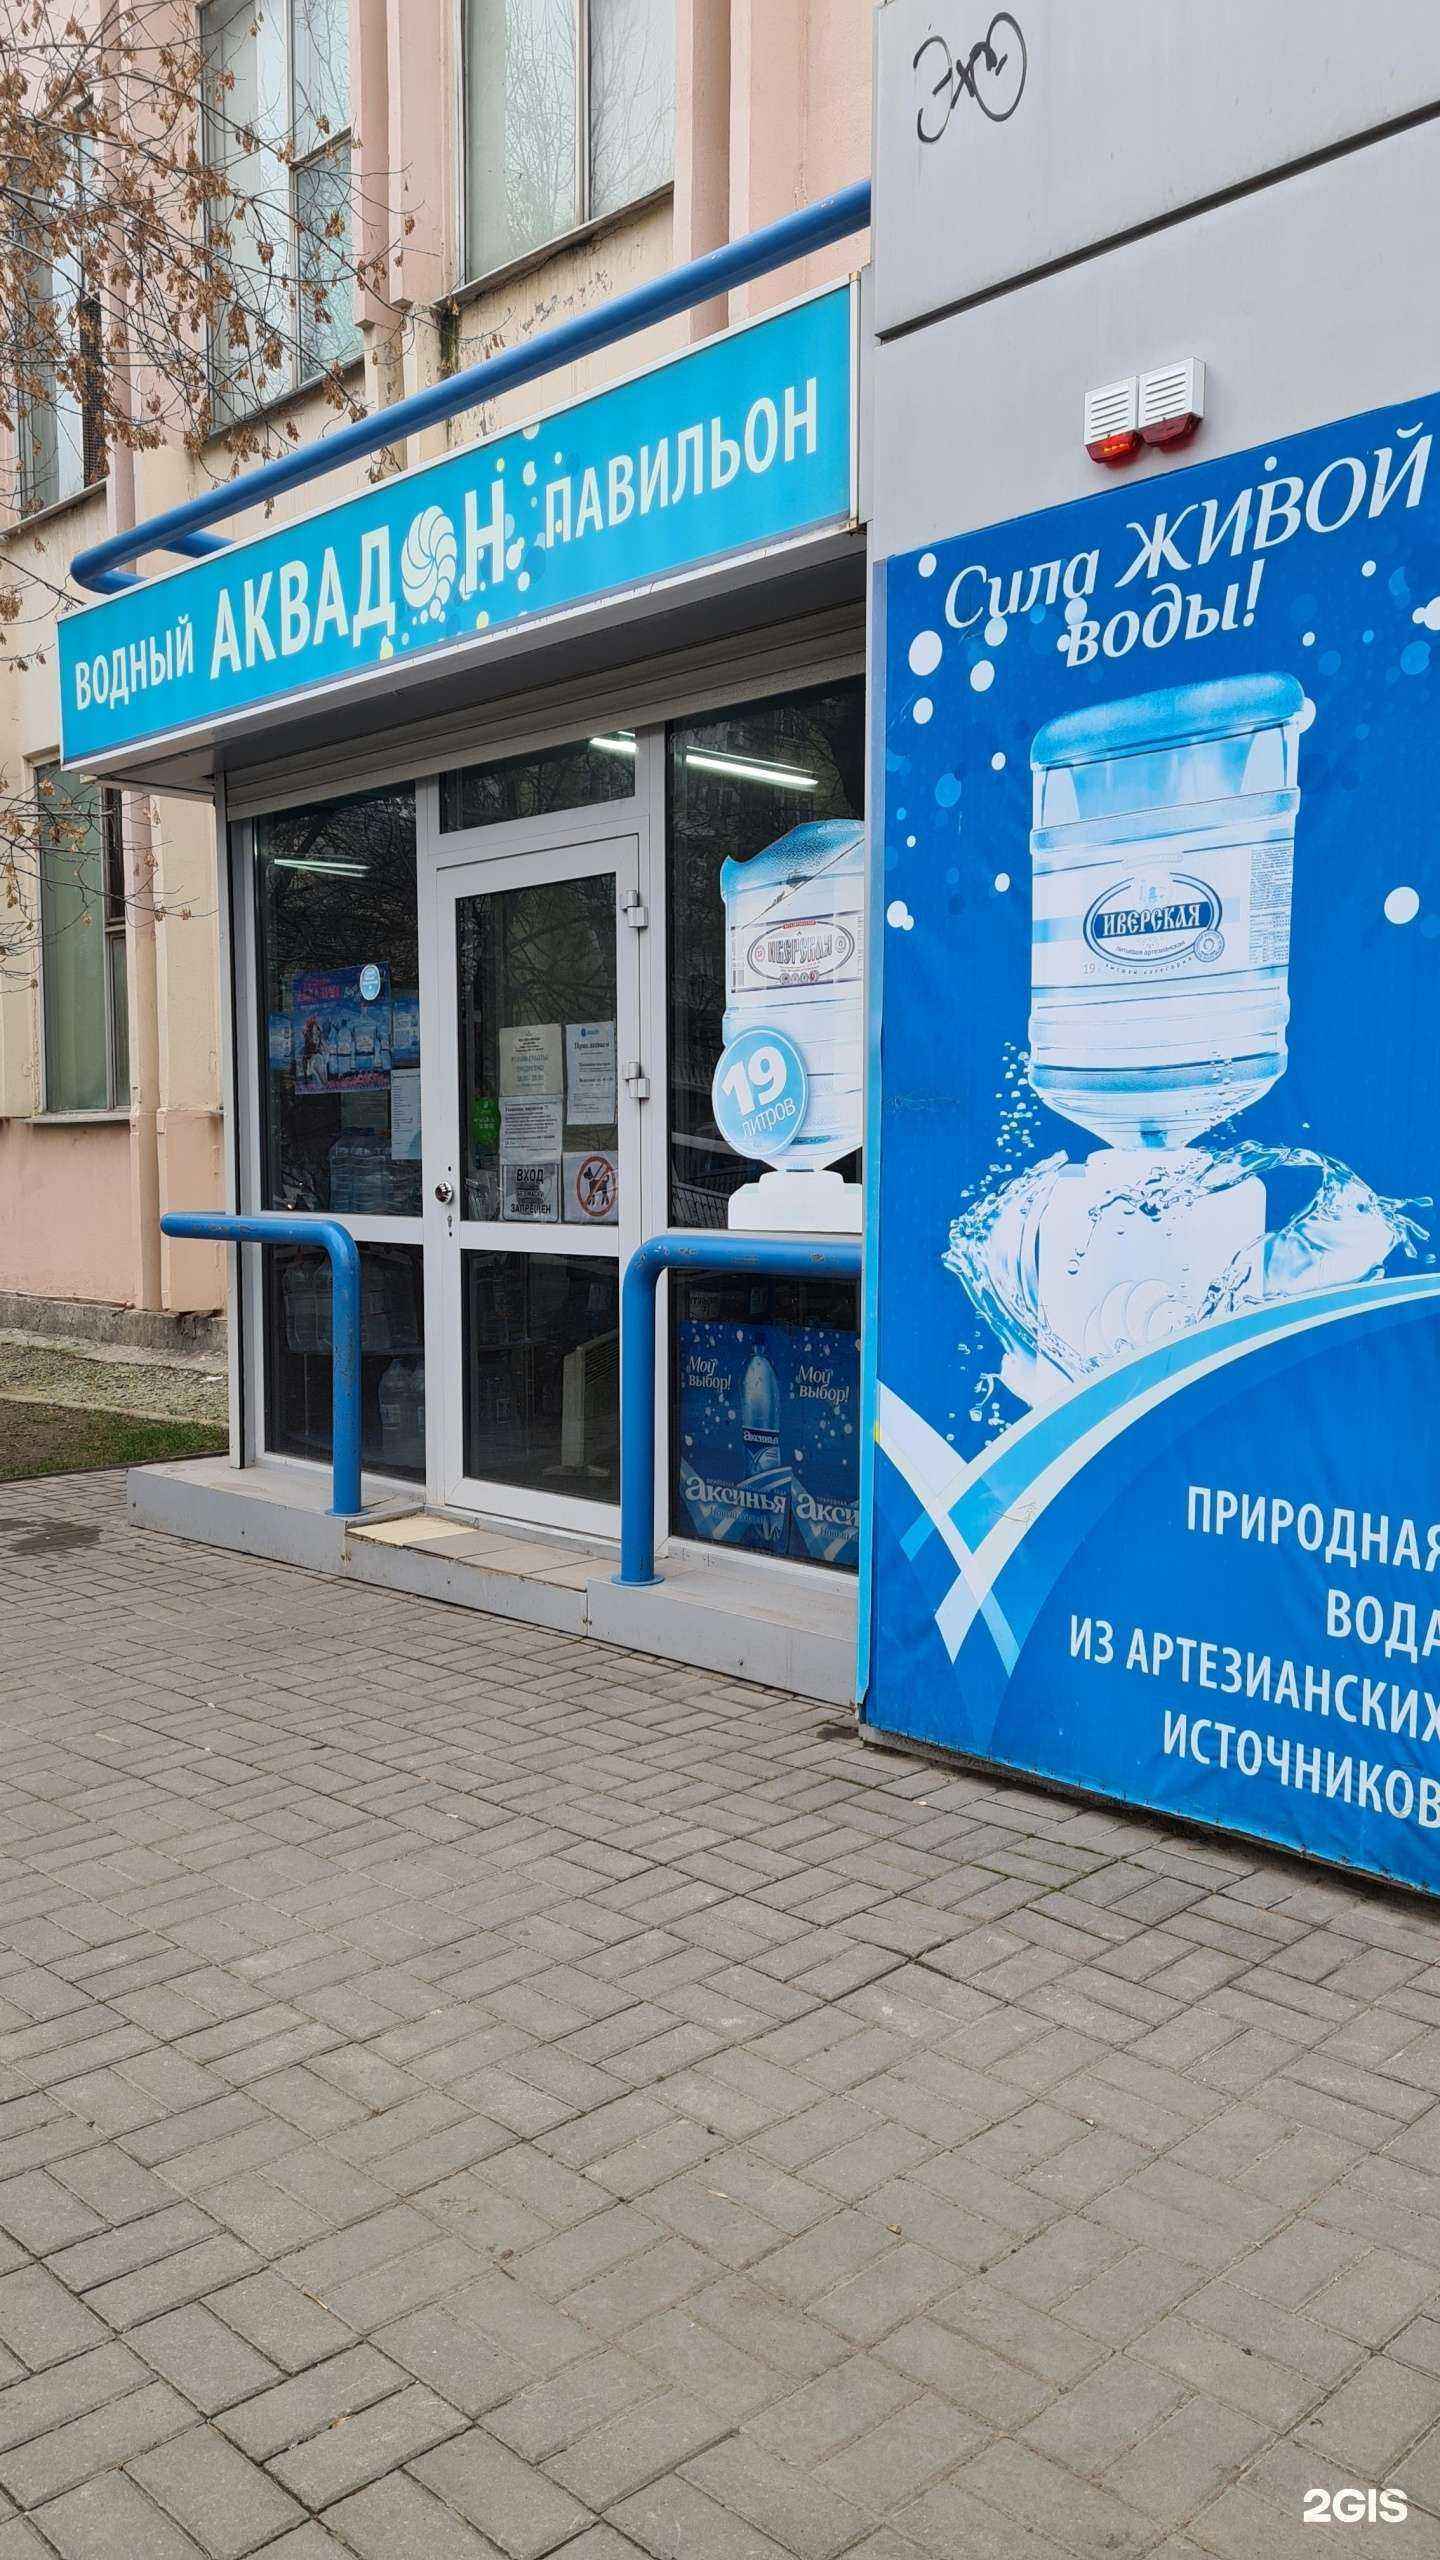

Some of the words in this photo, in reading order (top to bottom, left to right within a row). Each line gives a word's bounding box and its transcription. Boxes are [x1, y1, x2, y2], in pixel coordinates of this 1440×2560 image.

[73, 616, 195, 712] ВОДНЫЙ
[544, 377, 818, 549] ПАВИЛЬОН
[944, 548, 1101, 630] Сила
[1115, 421, 1435, 589] ЖИВОЙ
[1064, 559, 1266, 669] воды!
[1102, 903, 1201, 937] ИВЕРСКАЯ
[722, 1046, 787, 1116] 19
[516, 1168, 544, 1184] ВХОД
[688, 1355, 718, 1376] Мой
[688, 1374, 732, 1392] выбор!
[799, 1365, 833, 1387] Мой
[799, 1385, 850, 1405] выбор!
[1187, 1485, 1440, 1573] ПРИРОДНАЯ
[1326, 1588, 1440, 1665] ВОДА
[1069, 1614, 1115, 1665] ИЗ
[1125, 1627, 1440, 1744] АРТЕЗИАНСКИХ
[1163, 1709, 1440, 1829] ИСТОЧНИКОВ
